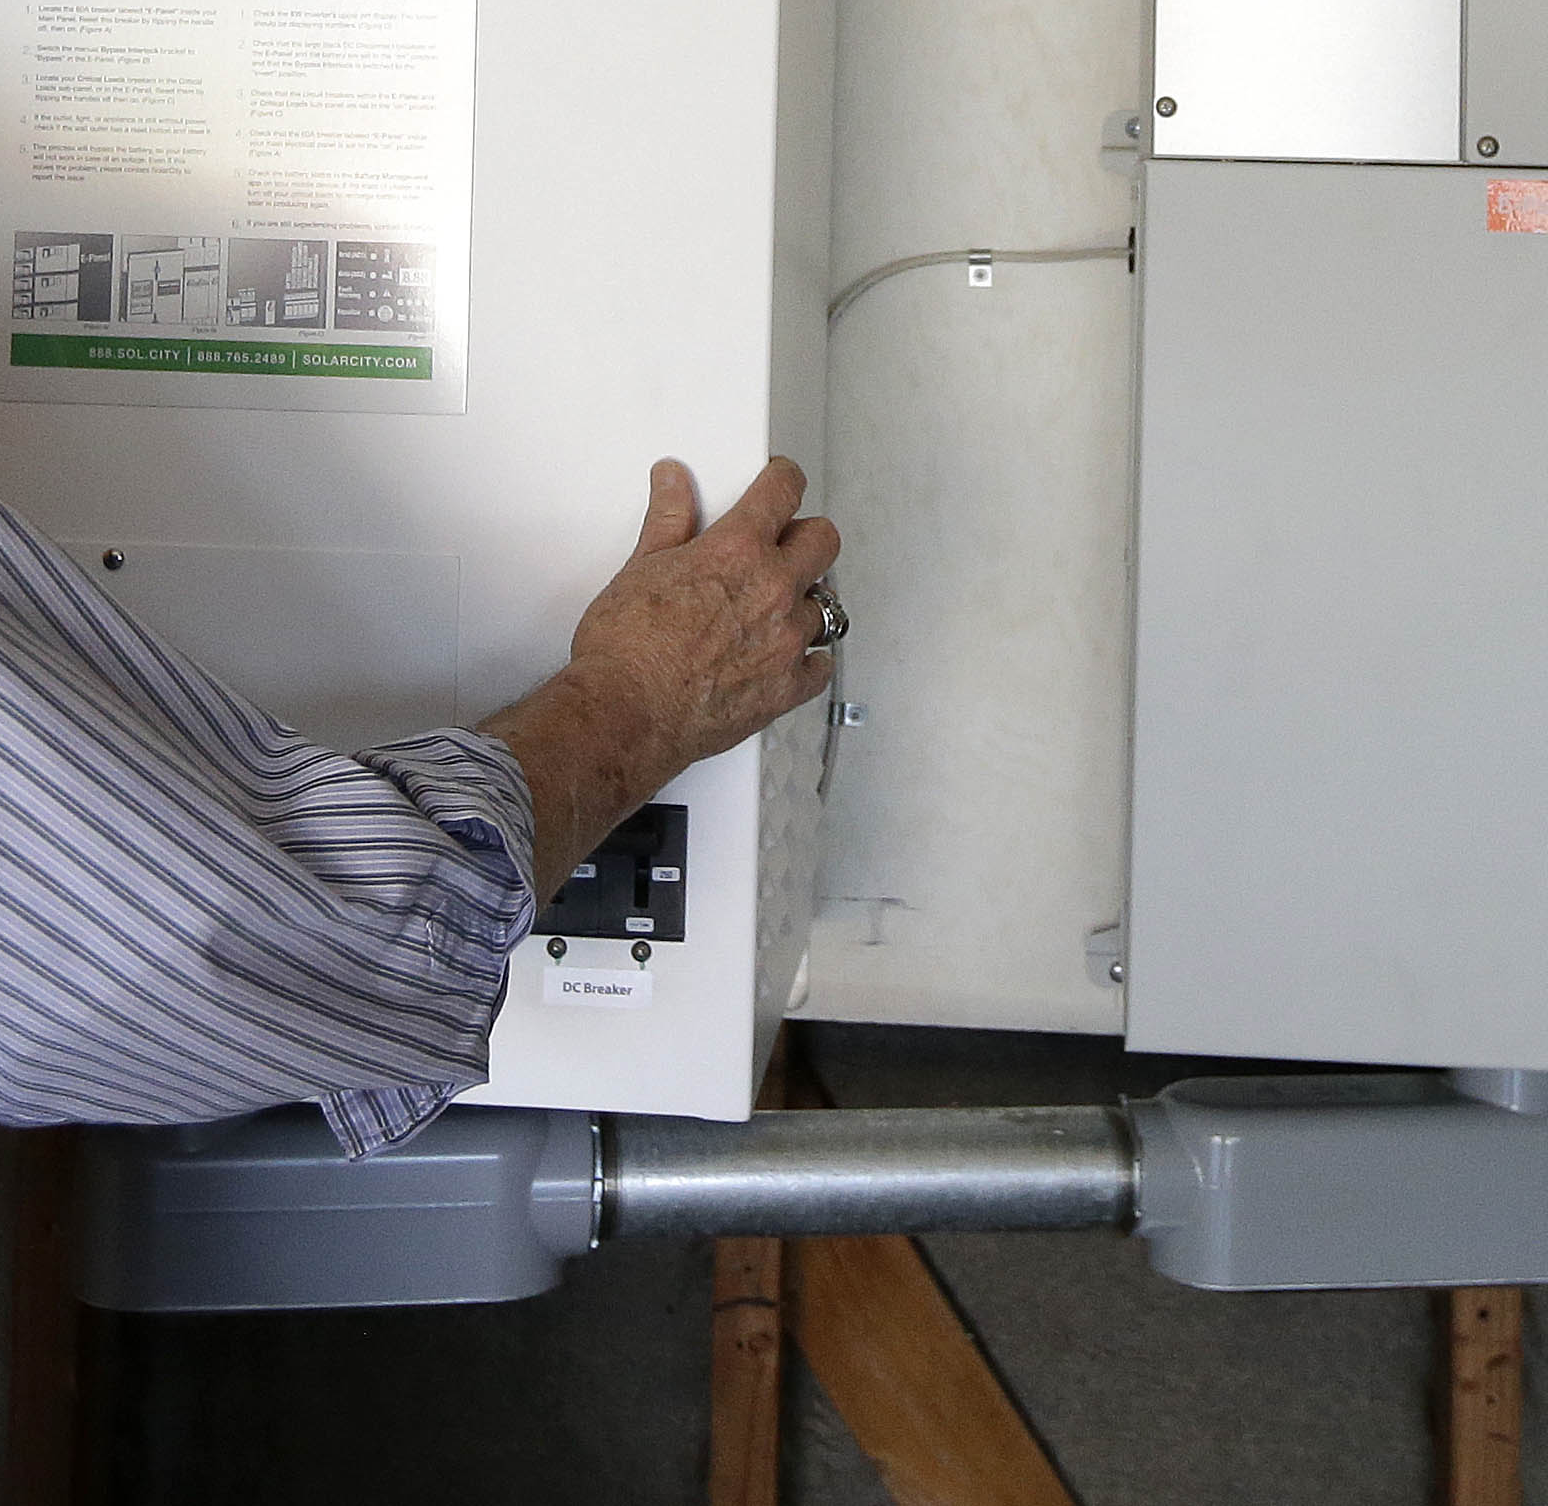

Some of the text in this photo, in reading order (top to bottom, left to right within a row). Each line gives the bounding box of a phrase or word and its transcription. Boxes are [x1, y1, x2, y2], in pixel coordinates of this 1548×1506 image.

[89, 346, 417, 369] 888.SOL.CITY 888.765.2489 SOLARCITY.COM
[563, 982, 633, 996] DC Breaker
